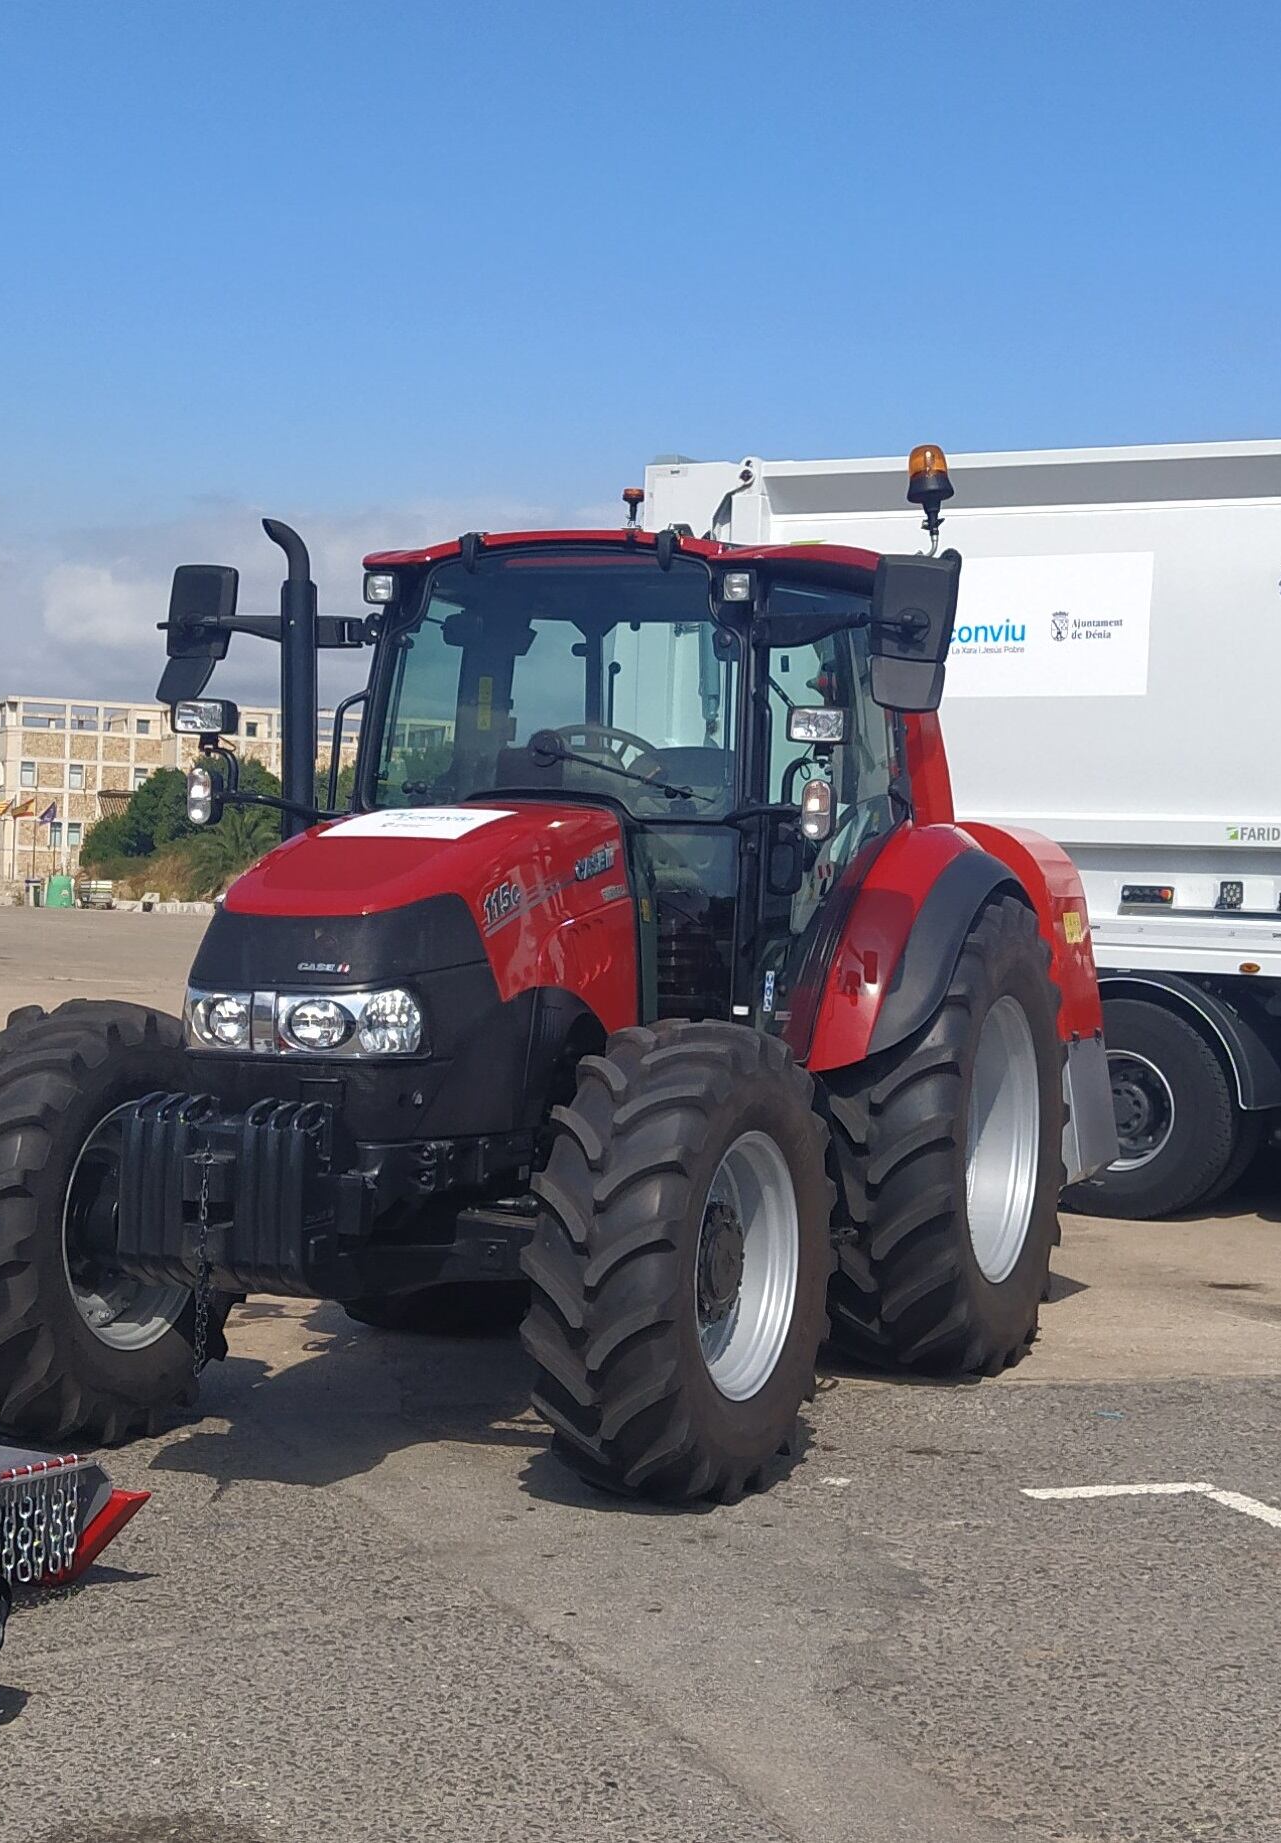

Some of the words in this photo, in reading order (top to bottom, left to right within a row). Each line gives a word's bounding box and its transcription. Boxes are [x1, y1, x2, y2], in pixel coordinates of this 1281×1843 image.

[1071, 618, 1123, 629] Ajuntament
[1071, 629, 1082, 640] de
[1085, 629, 1112, 640] Dénia
[1240, 826, 1281, 841] FARID
[297, 962, 336, 972] CASE
